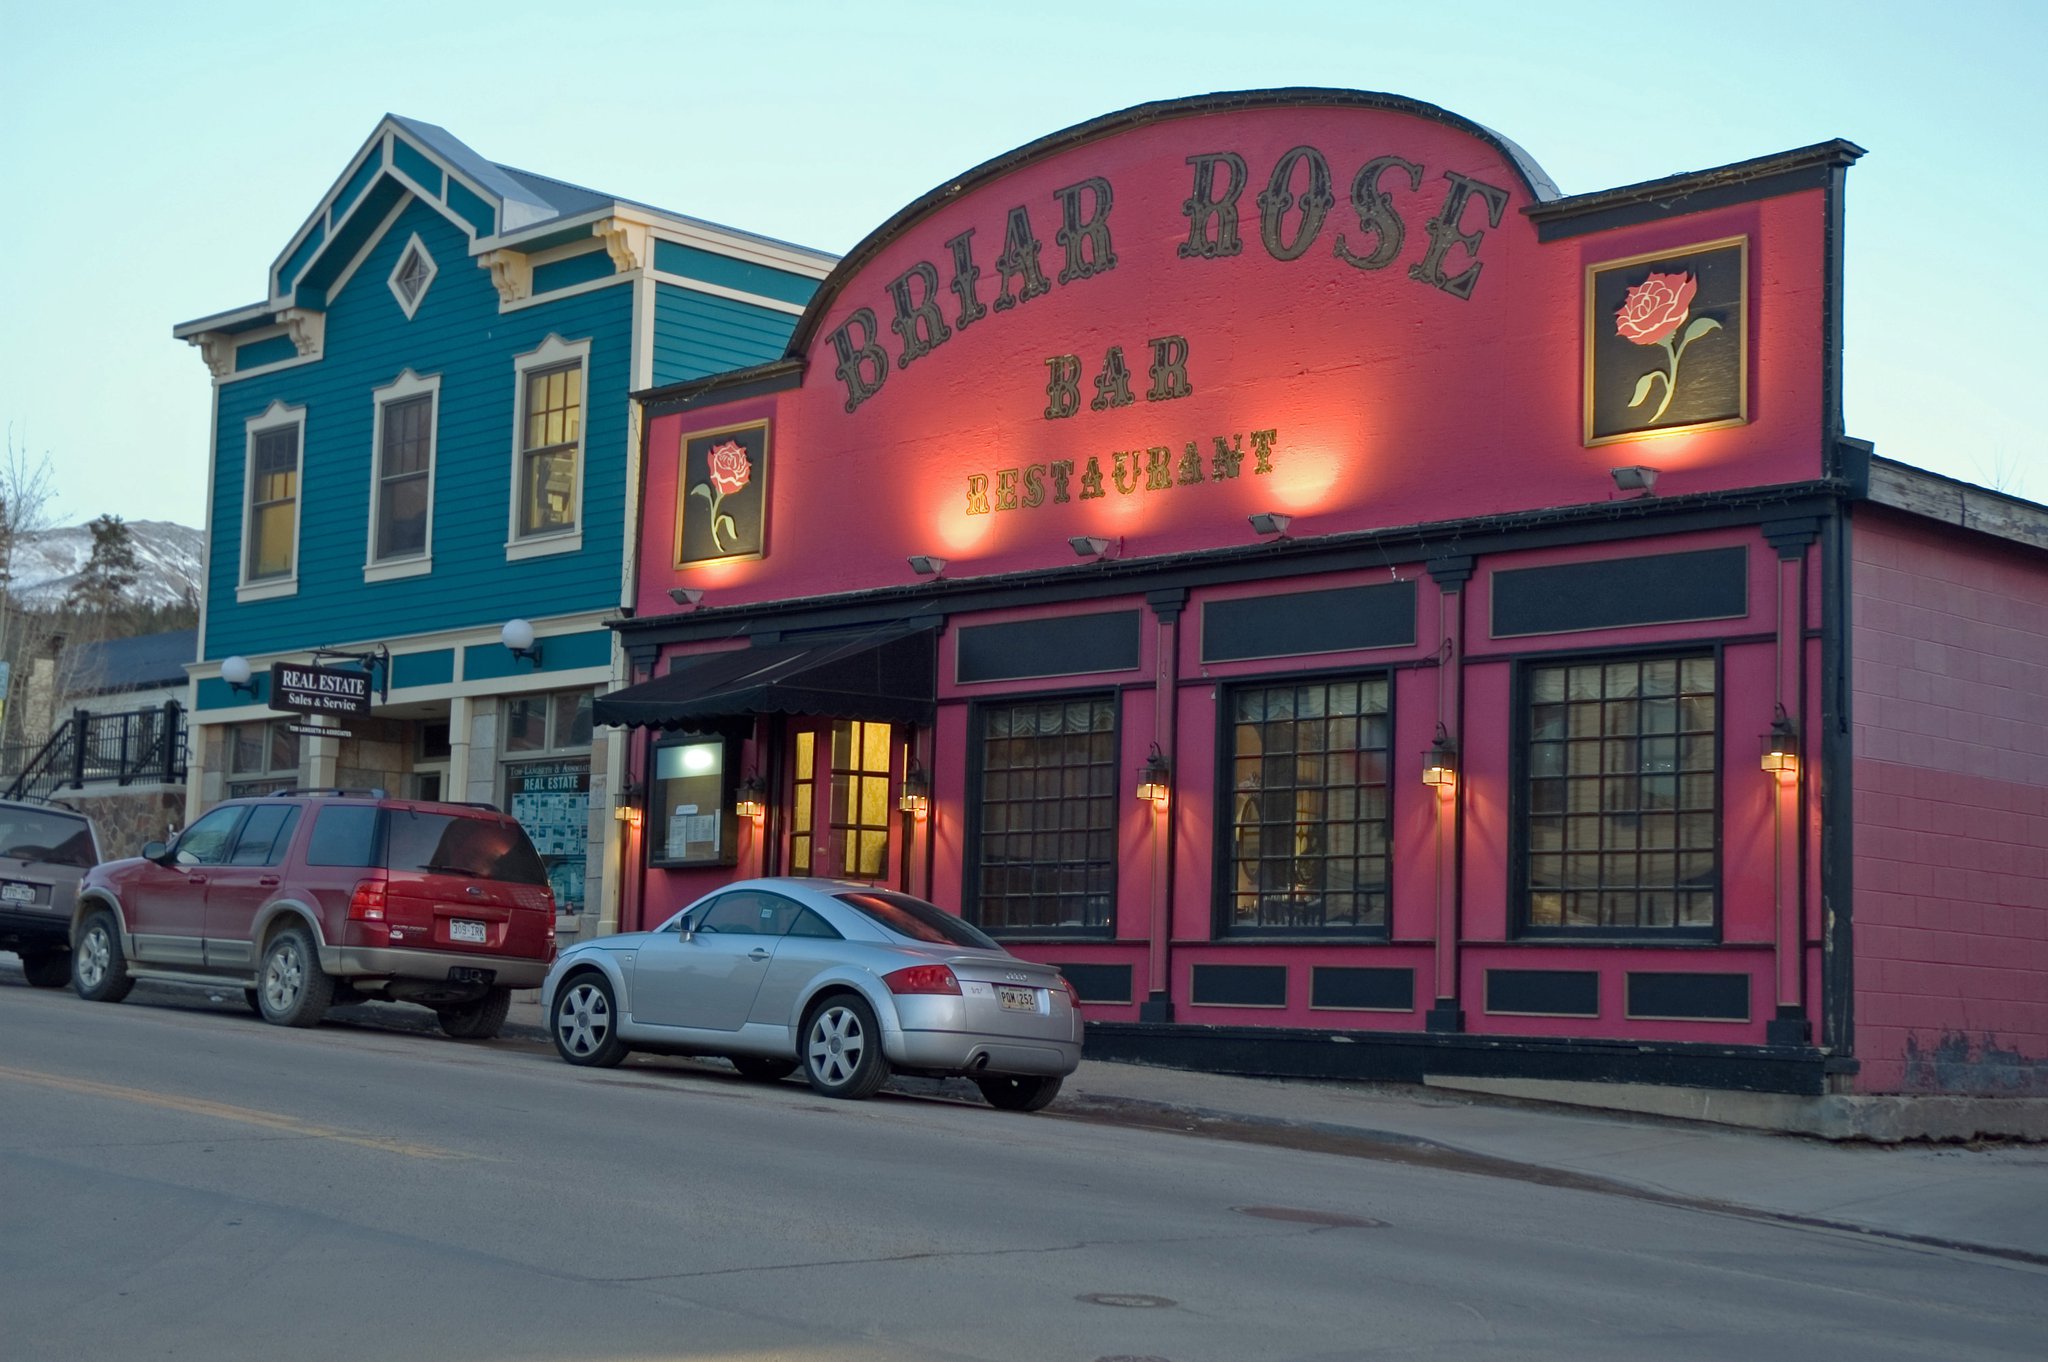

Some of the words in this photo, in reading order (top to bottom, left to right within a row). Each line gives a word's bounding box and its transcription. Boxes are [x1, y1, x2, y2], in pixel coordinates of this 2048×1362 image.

[825, 175, 1118, 413] BRIAR
[1177, 145, 1511, 301] ROSE
[1044, 334, 1193, 420] BAR
[965, 428, 1277, 516] RESTAURANT
[282, 670, 317, 689] REAL
[320, 675, 364, 695] ESTATE
[289, 693, 312, 706] Sales
[313, 698, 322, 707] &
[323, 697, 357, 711] Service
[524, 779, 544, 790] REAL
[548, 776, 578, 789] ESTATE
